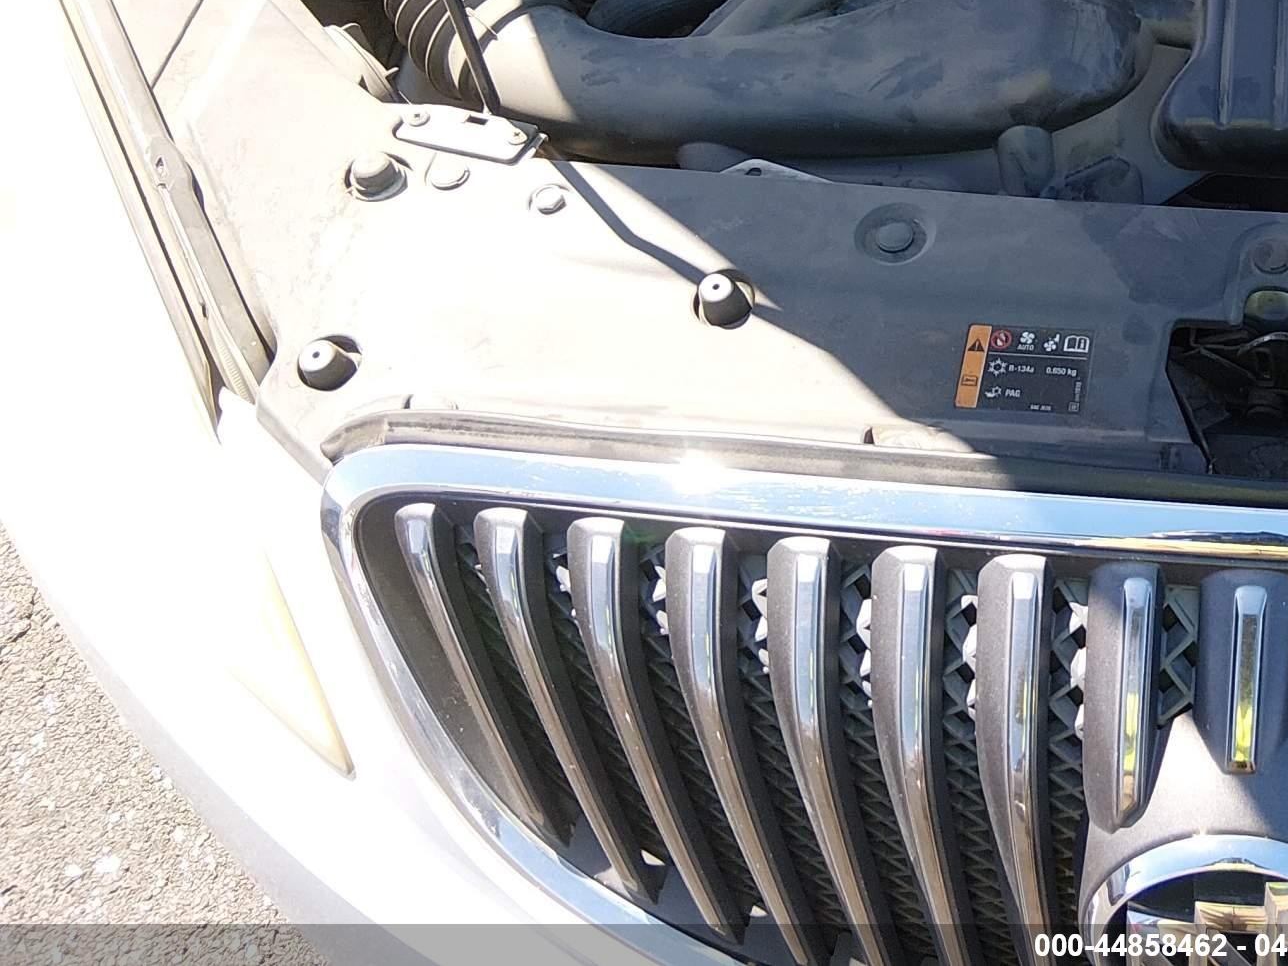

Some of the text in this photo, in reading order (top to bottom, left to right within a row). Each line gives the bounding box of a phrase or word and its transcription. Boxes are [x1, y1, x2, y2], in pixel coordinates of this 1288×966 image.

[1008, 365, 1035, 373] R-134a
[1066, 367, 1077, 377] kg
[1005, 388, 1021, 398] PAG
